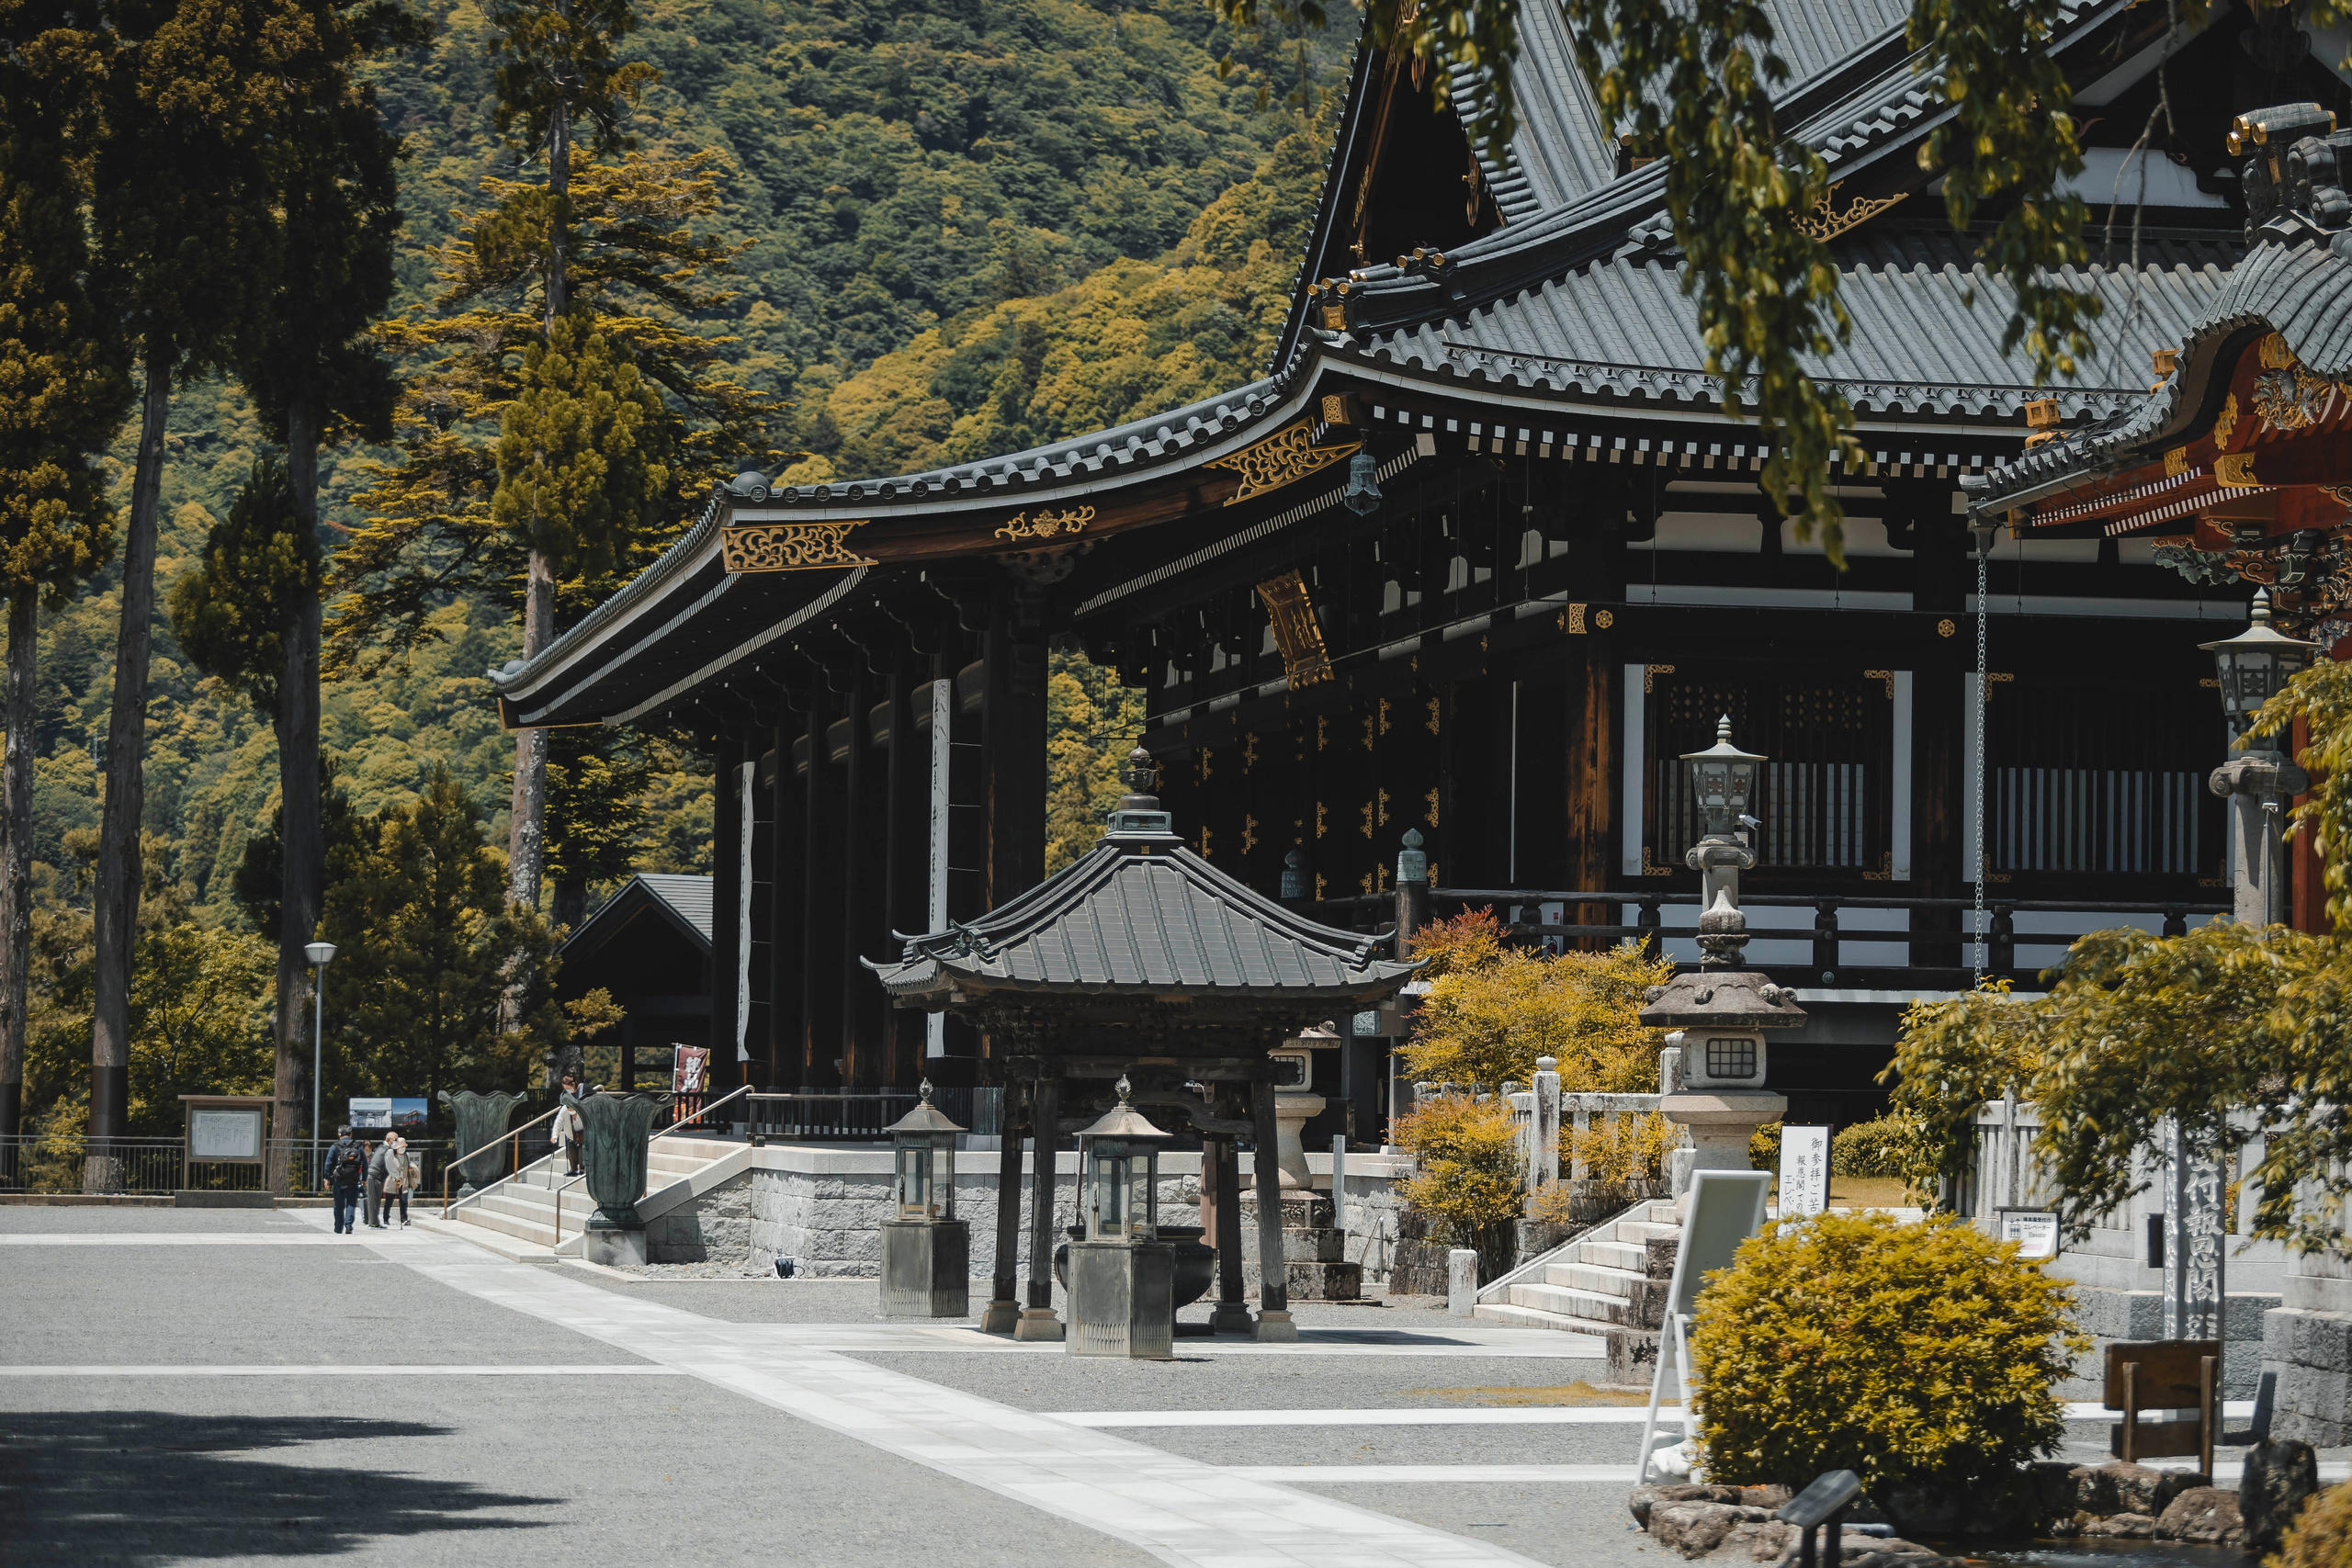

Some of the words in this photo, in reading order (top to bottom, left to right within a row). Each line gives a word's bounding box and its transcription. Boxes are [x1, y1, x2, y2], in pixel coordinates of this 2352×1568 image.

[1784, 1175, 1792, 1215] エレベー
[1796, 1154, 1807, 1213] 報恩閣での
[1808, 1137, 1823, 1215] 御参拝ご苦
[2183, 1124, 2223, 1303] 受付報恩閣
